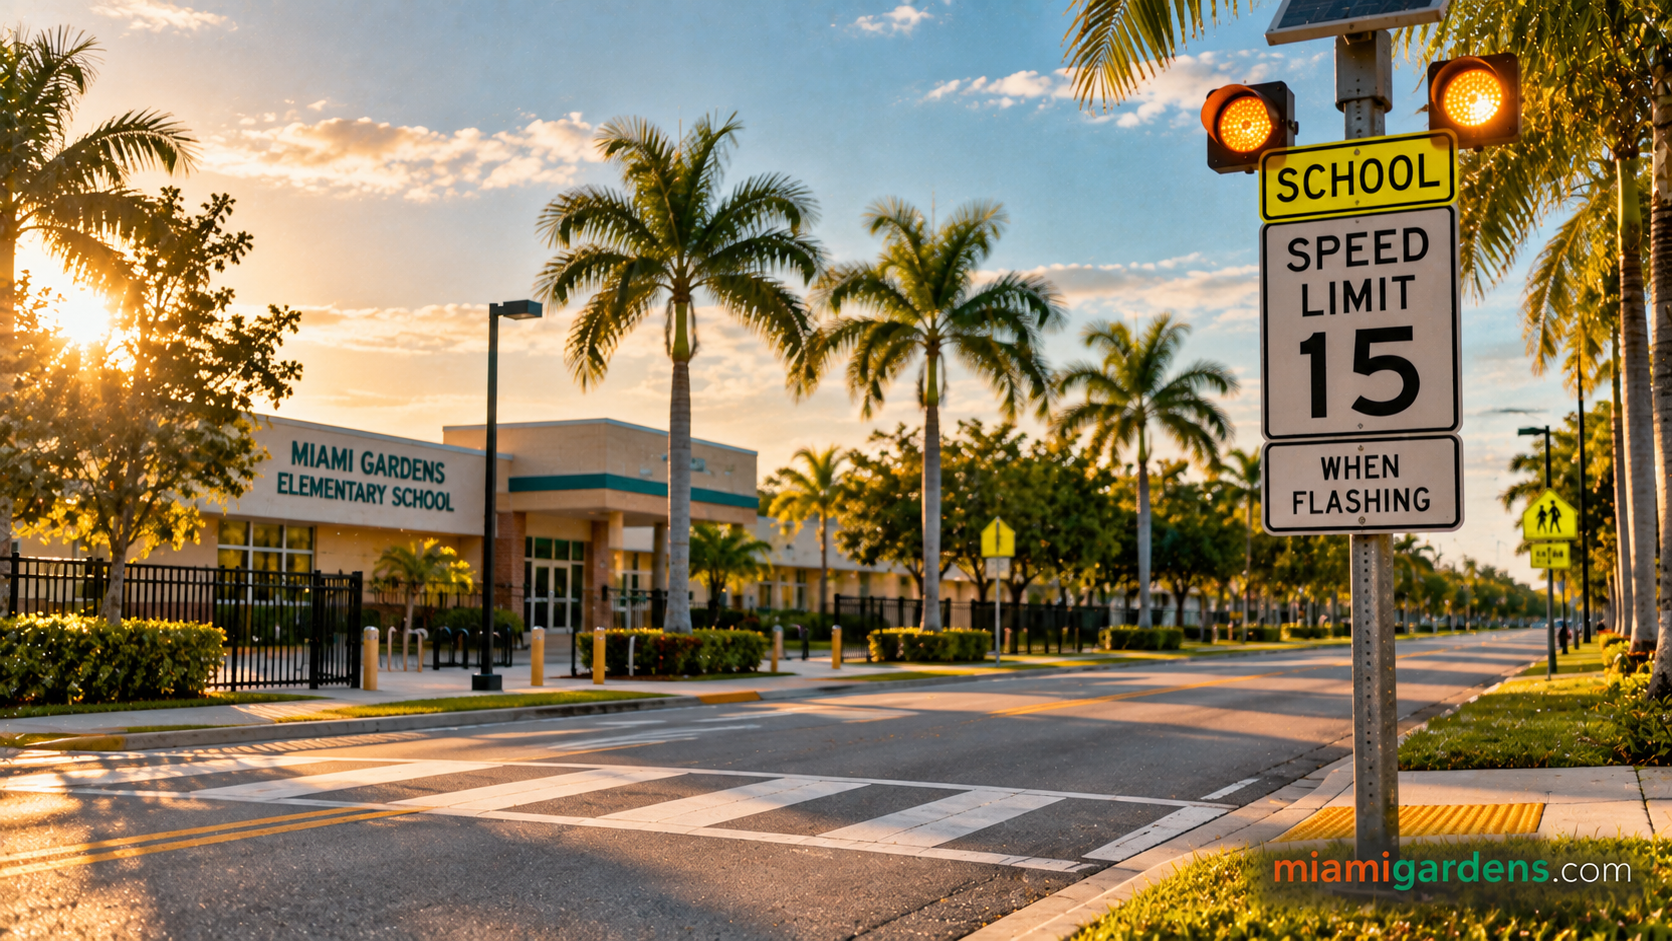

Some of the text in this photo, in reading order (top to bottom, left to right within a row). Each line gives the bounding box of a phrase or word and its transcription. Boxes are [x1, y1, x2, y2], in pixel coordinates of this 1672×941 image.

[1276, 153, 1441, 203] SCHOOL
[1286, 226, 1429, 273] SPEED
[1301, 275, 1416, 318] LIMIT
[1299, 325, 1421, 419] 15
[291, 440, 446, 484] MIAMI GARDENS
[1320, 454, 1400, 481] WHEN
[277, 471, 455, 512] ELEMENTARY SCHOOL
[1292, 486, 1431, 515] FLASHING
